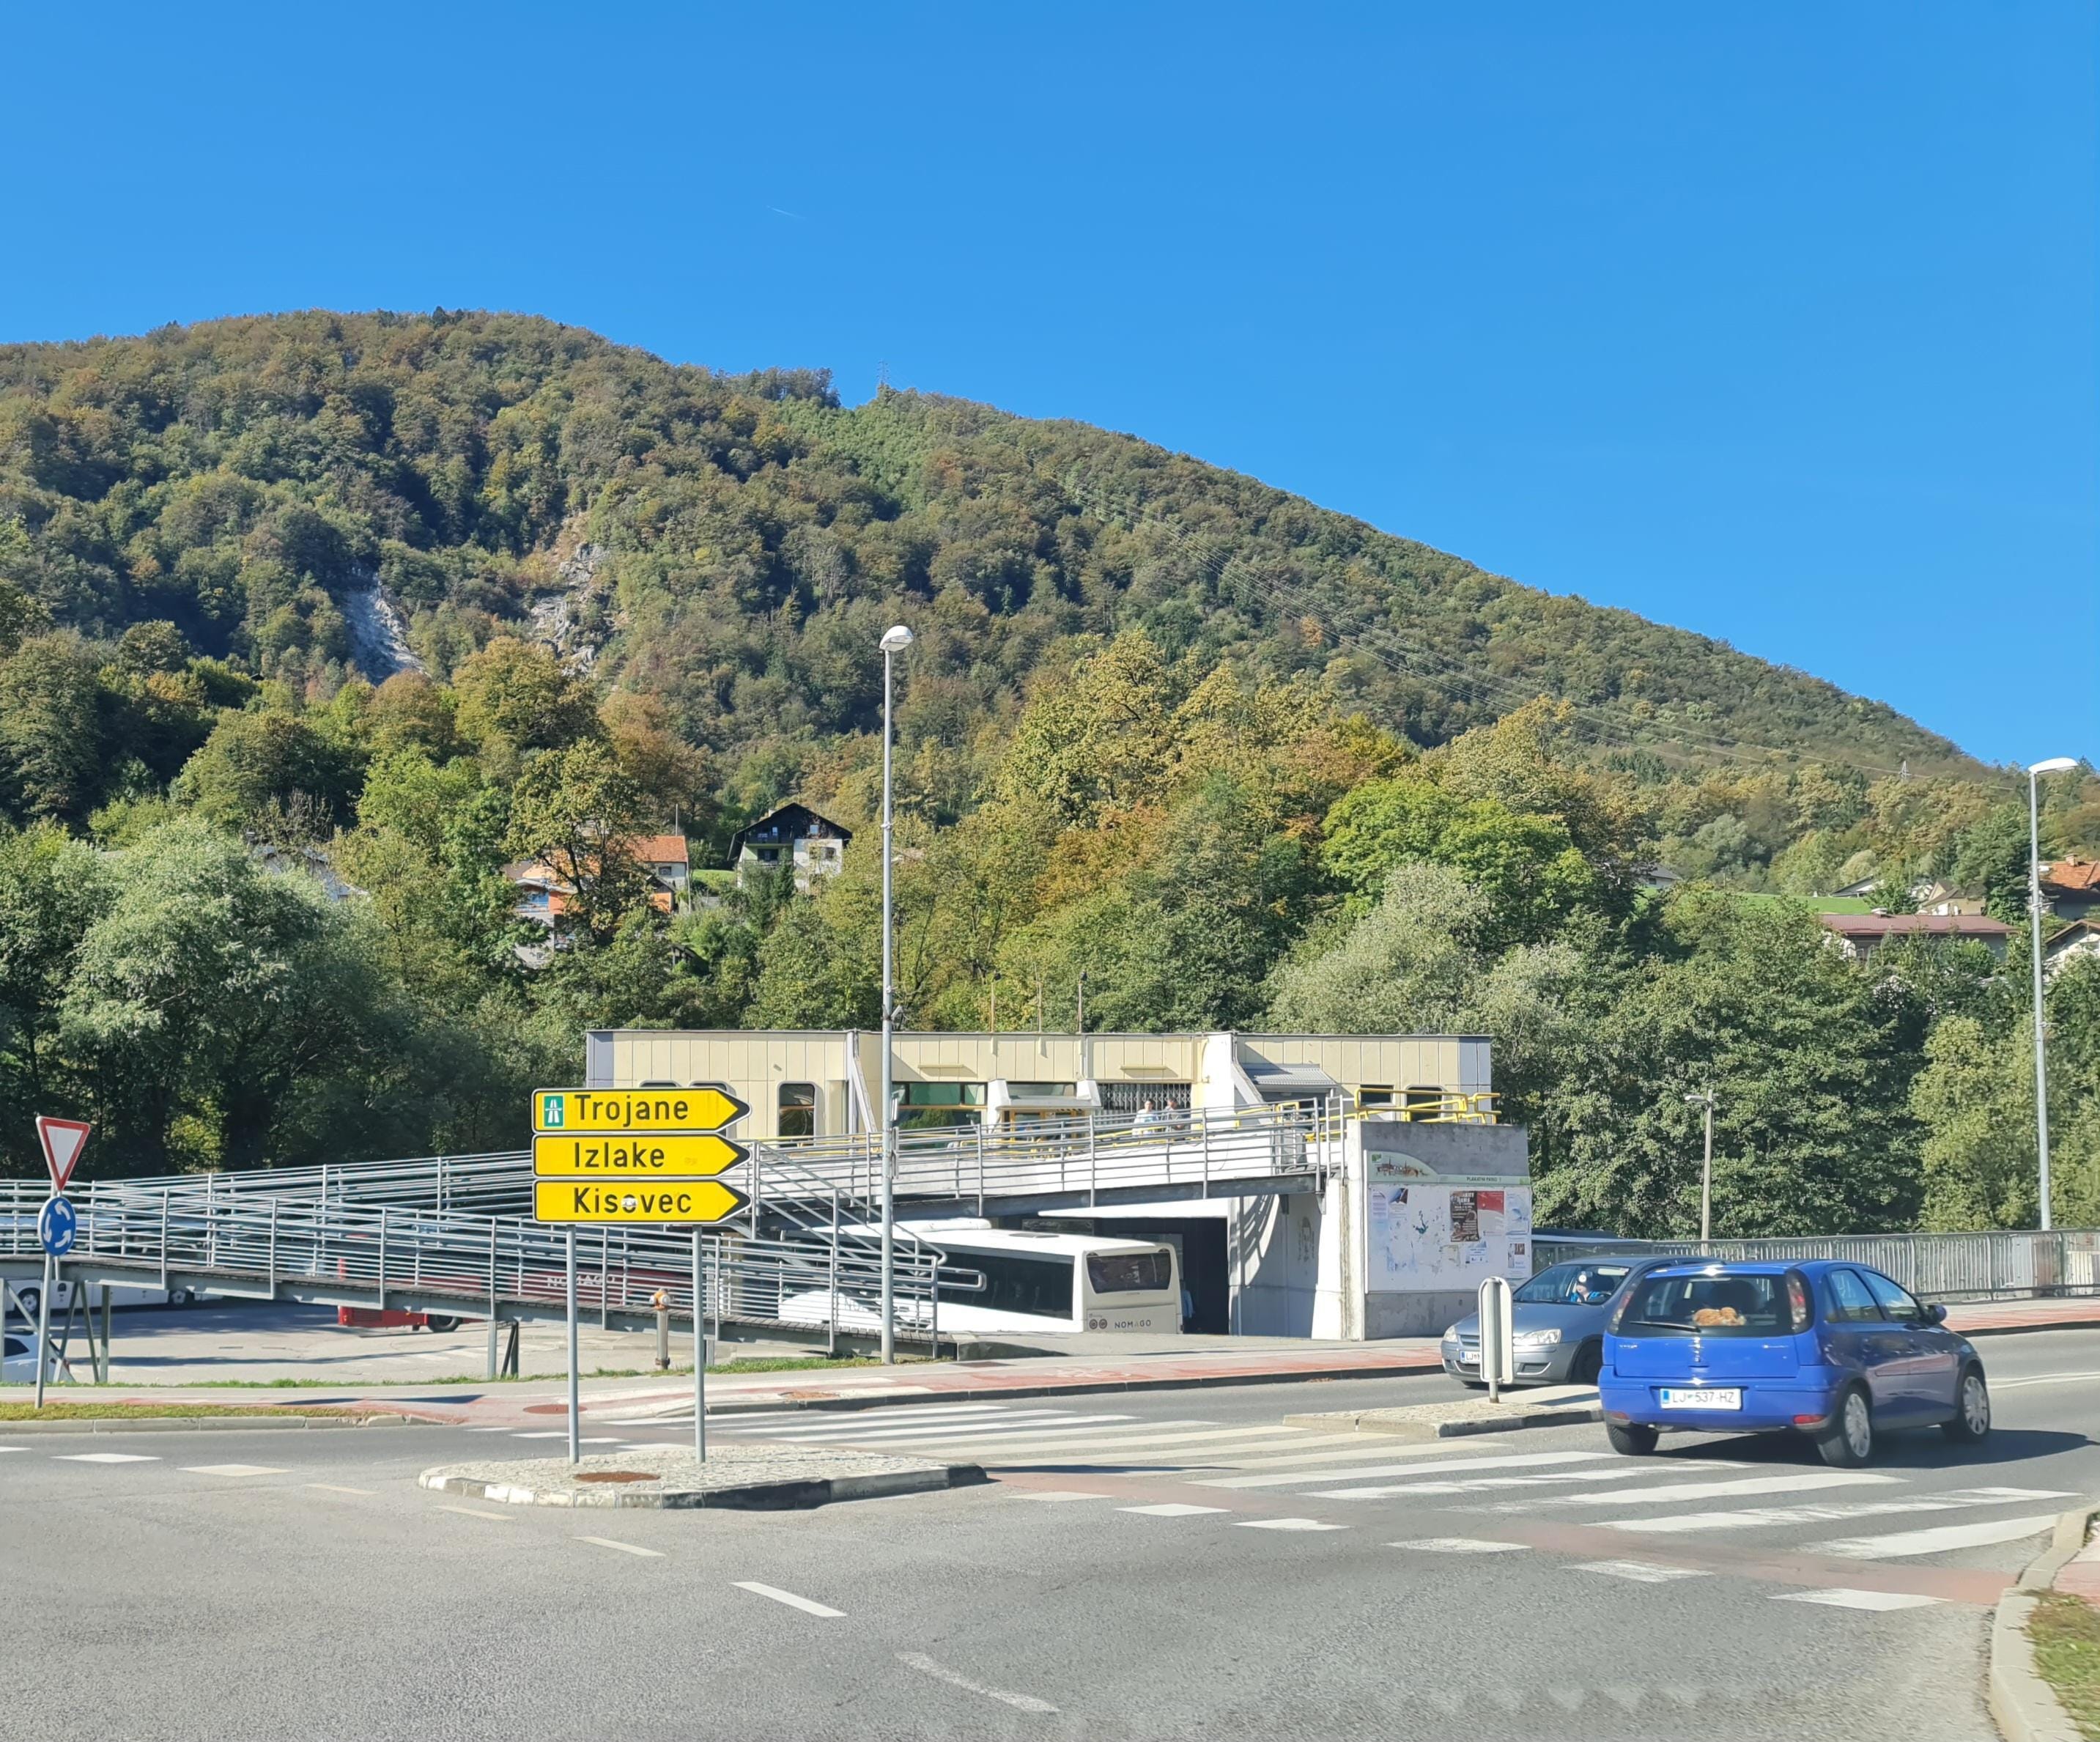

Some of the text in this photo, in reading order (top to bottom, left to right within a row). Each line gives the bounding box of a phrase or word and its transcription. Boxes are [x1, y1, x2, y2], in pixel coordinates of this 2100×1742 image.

[574, 1094, 688, 1127] Trojane
[574, 1142, 665, 1167] Izlake
[1114, 1319, 1151, 1329] NOMAGO
